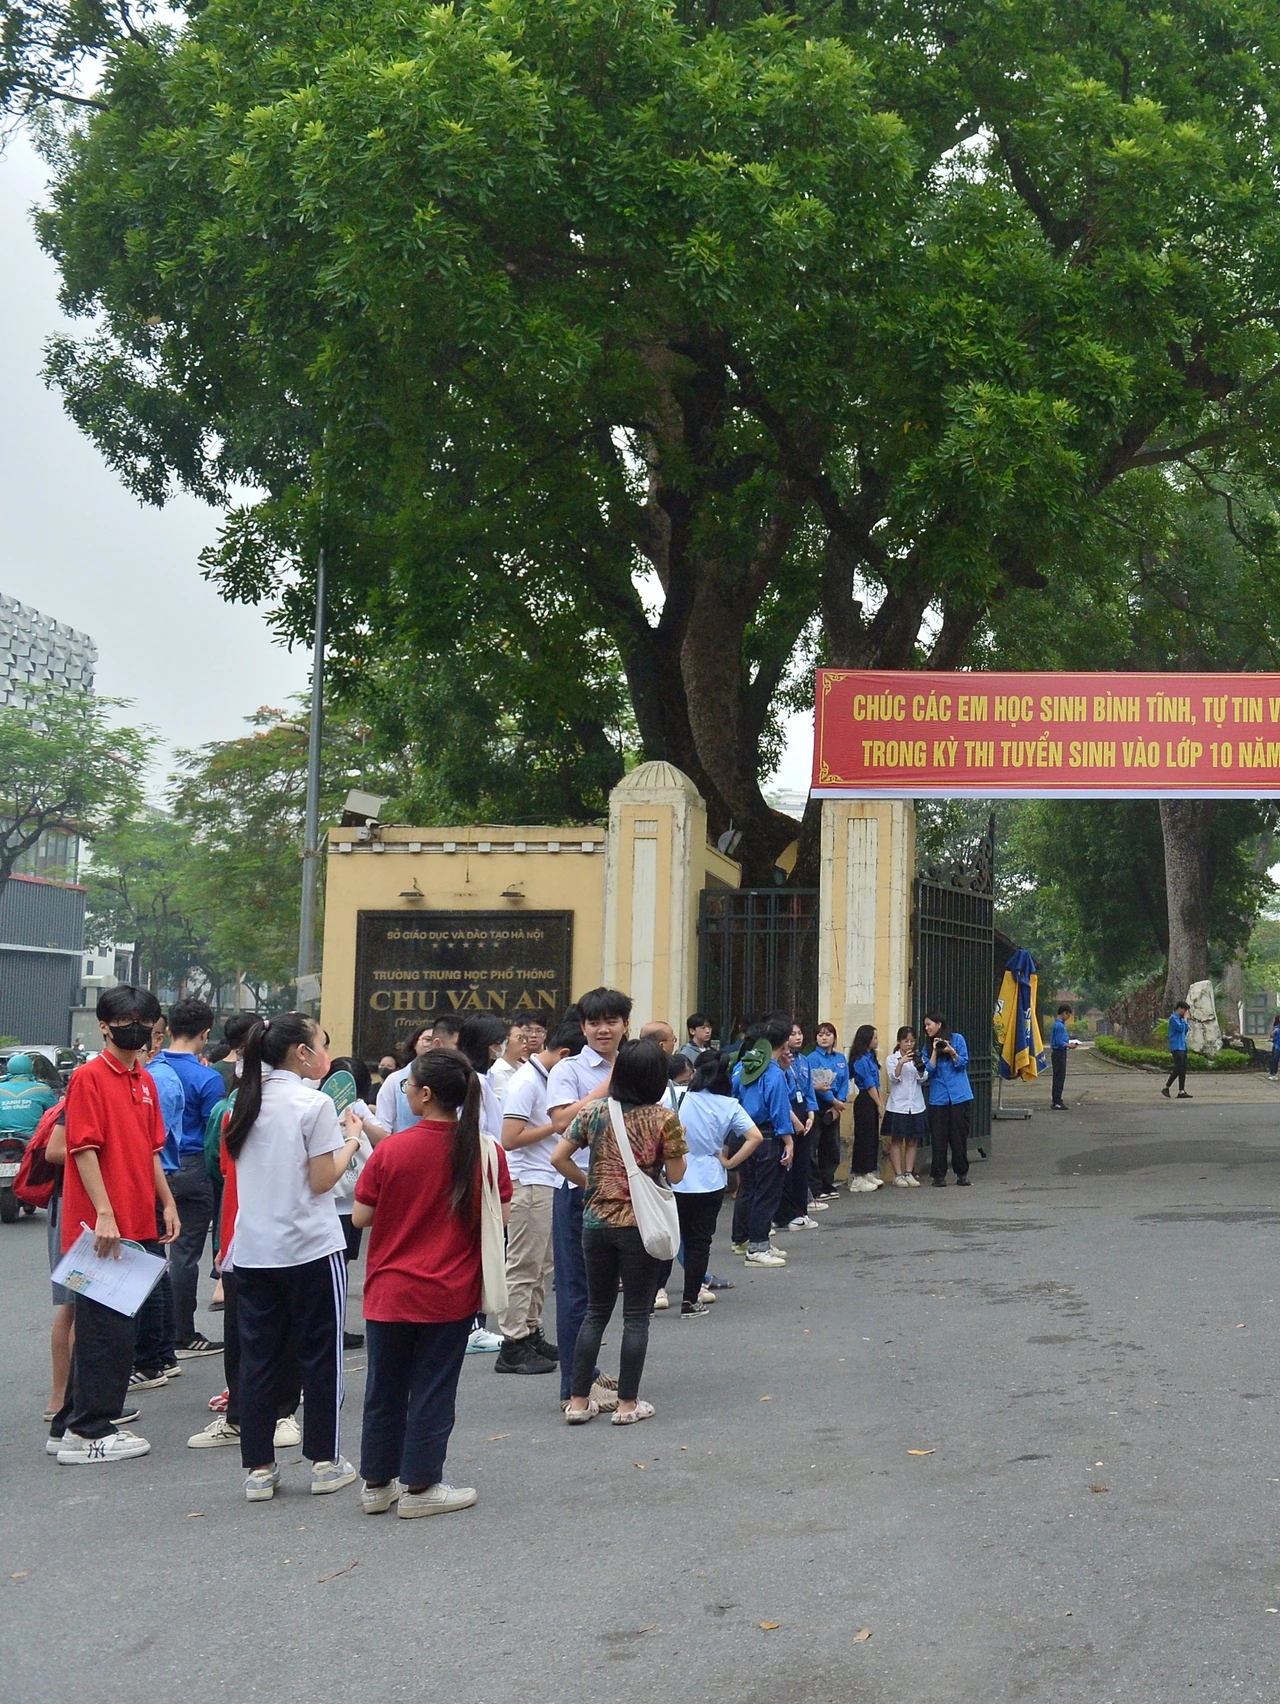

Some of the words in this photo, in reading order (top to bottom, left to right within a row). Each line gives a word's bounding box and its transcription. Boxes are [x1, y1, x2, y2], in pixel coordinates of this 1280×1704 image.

[853, 690, 906, 722] CHÚC
[912, 690, 952, 722] CÁC
[957, 695, 989, 722] EM
[994, 695, 1035, 728] HỌC
[1040, 695, 1087, 723] SINH
[1093, 691, 1141, 723] BÌNH
[1146, 691, 1197, 726] TĨNH,
[1202, 694, 1229, 729] TỰ
[1231, 697, 1264, 723] TIN
[861, 740, 927, 768] TRONG
[933, 735, 959, 768] KỲ
[964, 741, 995, 768] THI
[1001, 731, 1064, 768] TUYỂN
[1069, 739, 1117, 768] SINH
[1122, 736, 1161, 768] VÀO
[1166, 736, 1203, 768] LỚP
[1209, 742, 1233, 768] 10
[402, 929, 427, 940] GIÁO
[429, 931, 449, 941] DỤC
[451, 929, 465, 940] VÀ
[466, 929, 488, 940] ĐÀO
[490, 931, 509, 941] TẠO
[511, 929, 524, 939] HÀ
[526, 929, 544, 941] NỘI
[373, 968, 420, 980] TRƯỜNG
[423, 970, 461, 980] TRUNG
[464, 970, 488, 982] HỌC
[490, 966, 514, 980] PHỔ
[517, 968, 555, 979] THÔNG
[369, 990, 439, 1011] CHU
[446, 983, 508, 1011] VĂN
[514, 989, 558, 1010] AN
